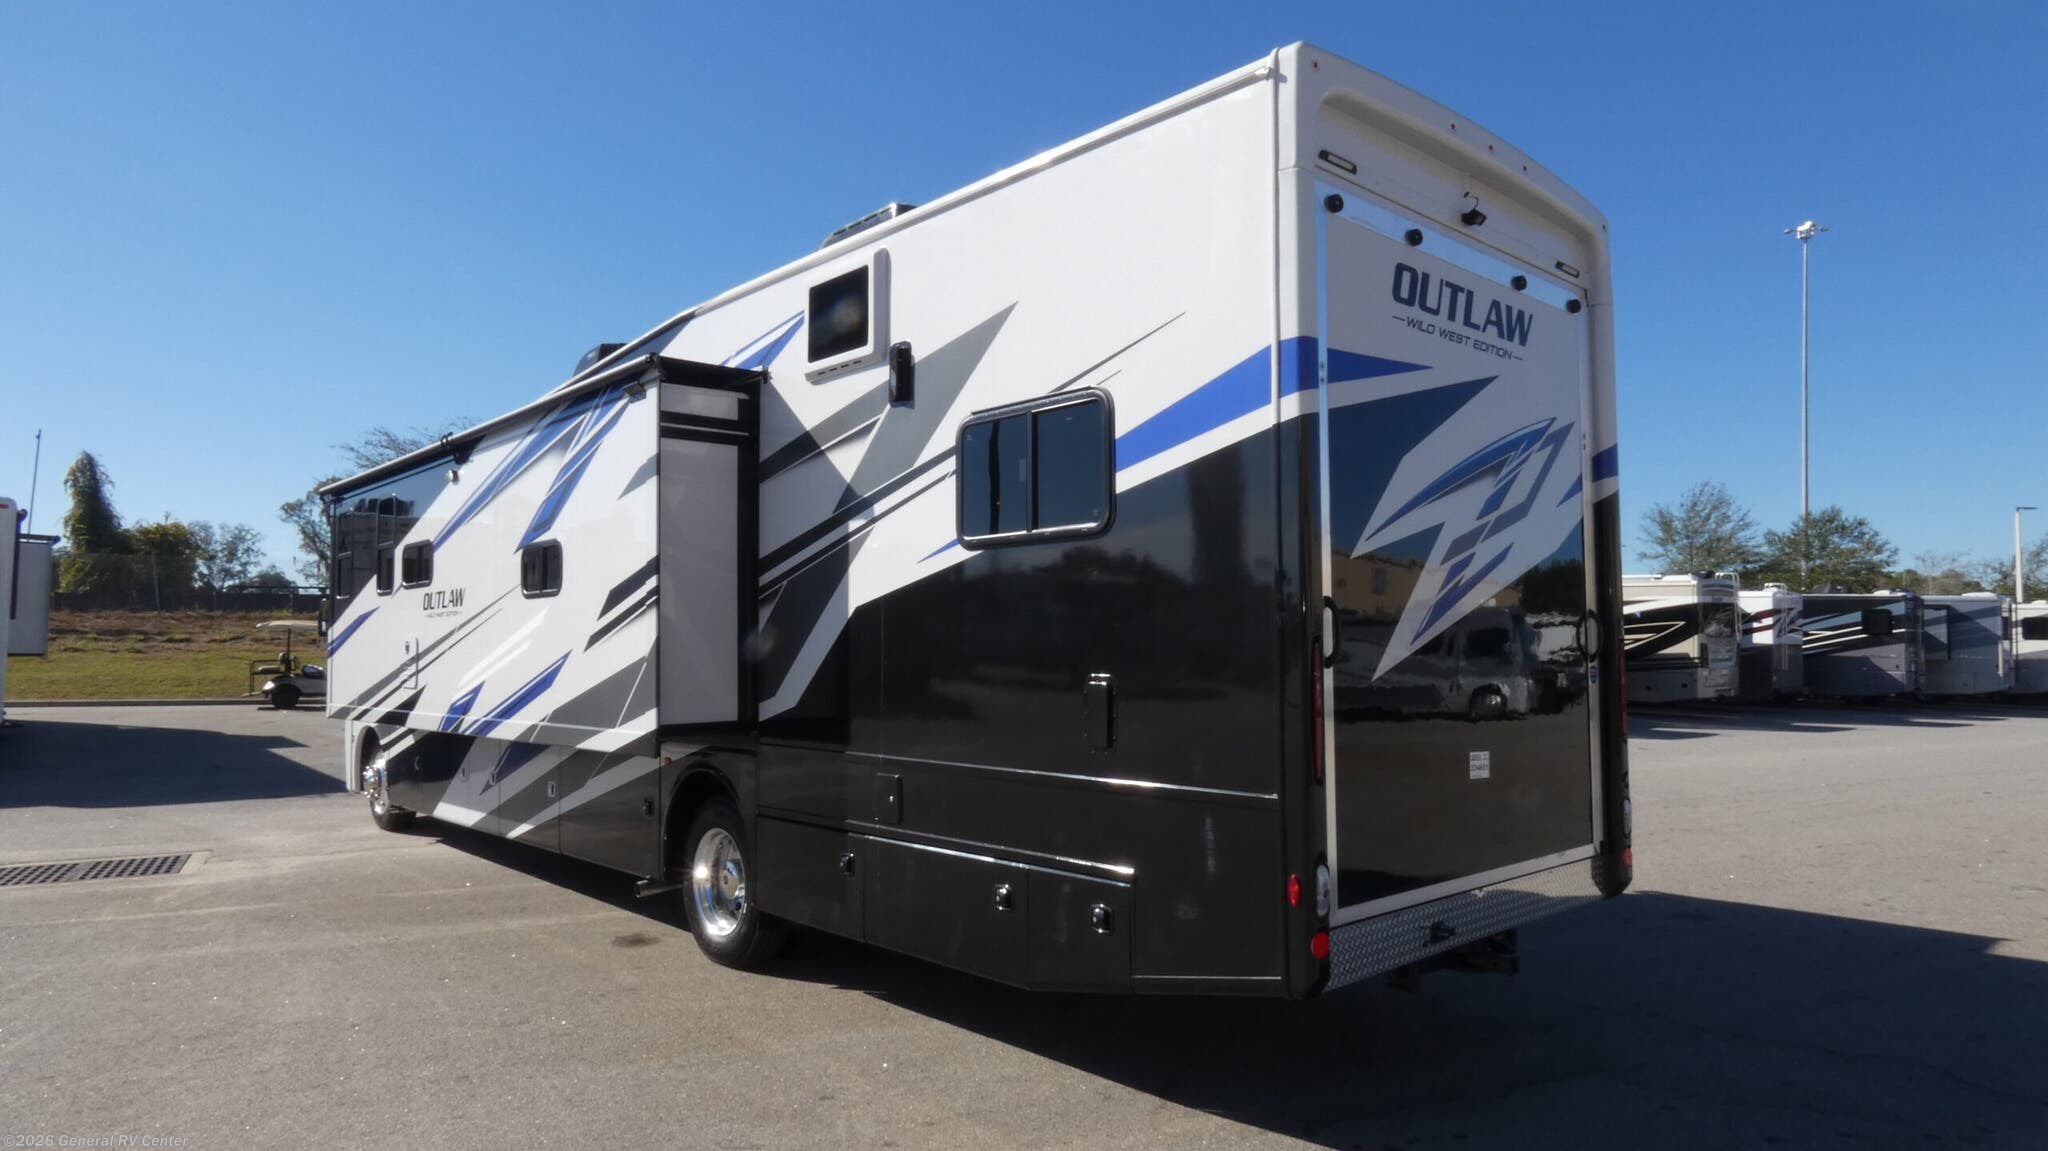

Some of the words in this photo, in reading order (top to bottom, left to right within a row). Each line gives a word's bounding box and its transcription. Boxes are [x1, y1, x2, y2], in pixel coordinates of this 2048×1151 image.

[1392, 262, 1533, 347] OUTLAW
[1406, 315, 1436, 335] WILD
[1439, 327, 1471, 346] WEST
[1472, 339, 1513, 360] EDITION
[423, 588, 465, 611] OUTLAW
